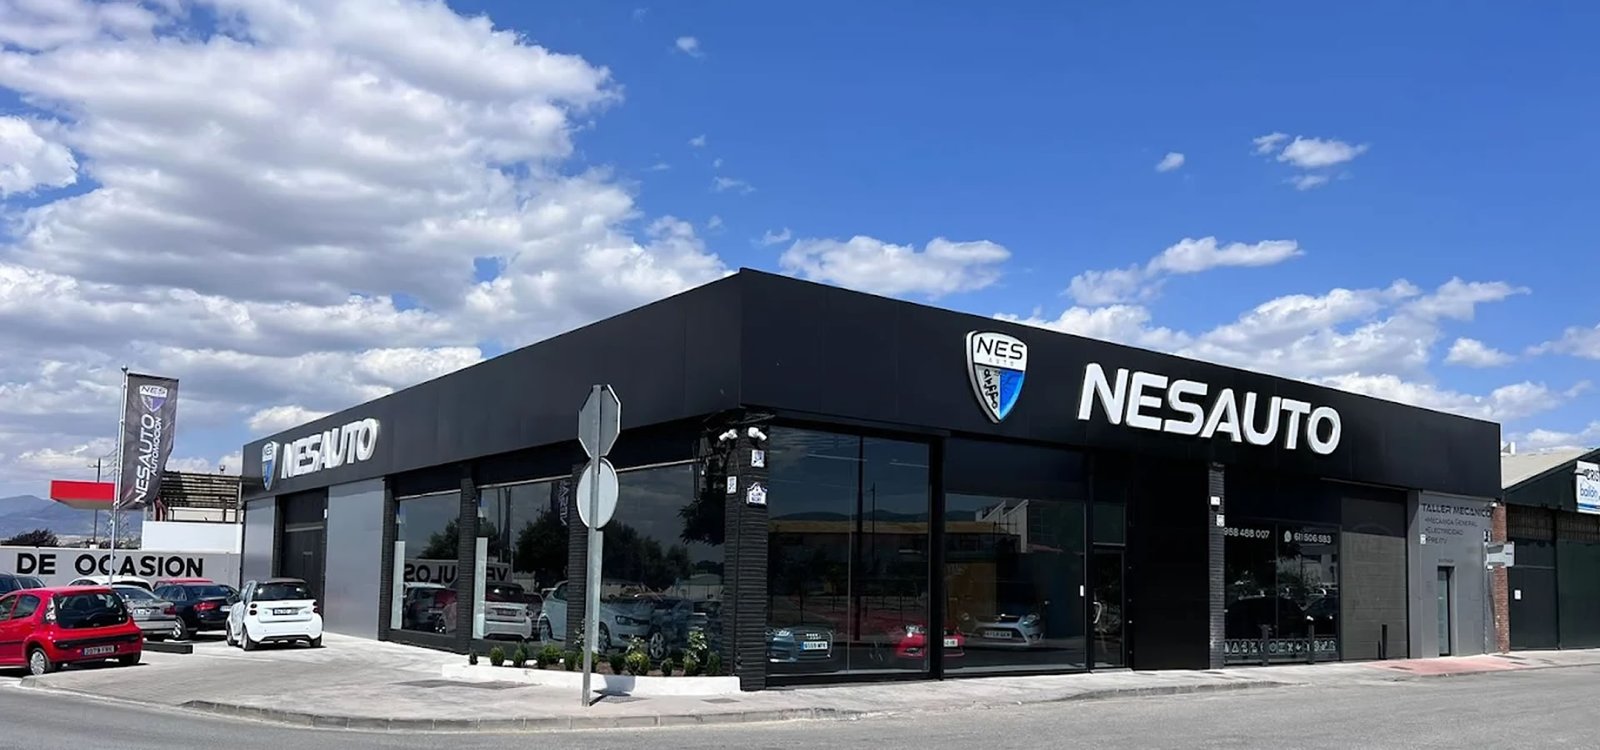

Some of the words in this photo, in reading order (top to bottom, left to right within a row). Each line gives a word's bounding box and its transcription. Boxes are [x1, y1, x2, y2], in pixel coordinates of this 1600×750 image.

[977, 337, 1023, 360] NES
[141, 386, 166, 395] NES
[1078, 363, 1342, 455] NESAUTO
[135, 413, 155, 503] NESAUTO
[281, 418, 379, 479] NESAUTO
[1421, 503, 1451, 514] TALLER
[1256, 530, 1270, 539] 007
[17, 553, 56, 575] DE
[75, 554, 203, 578] OCASION
